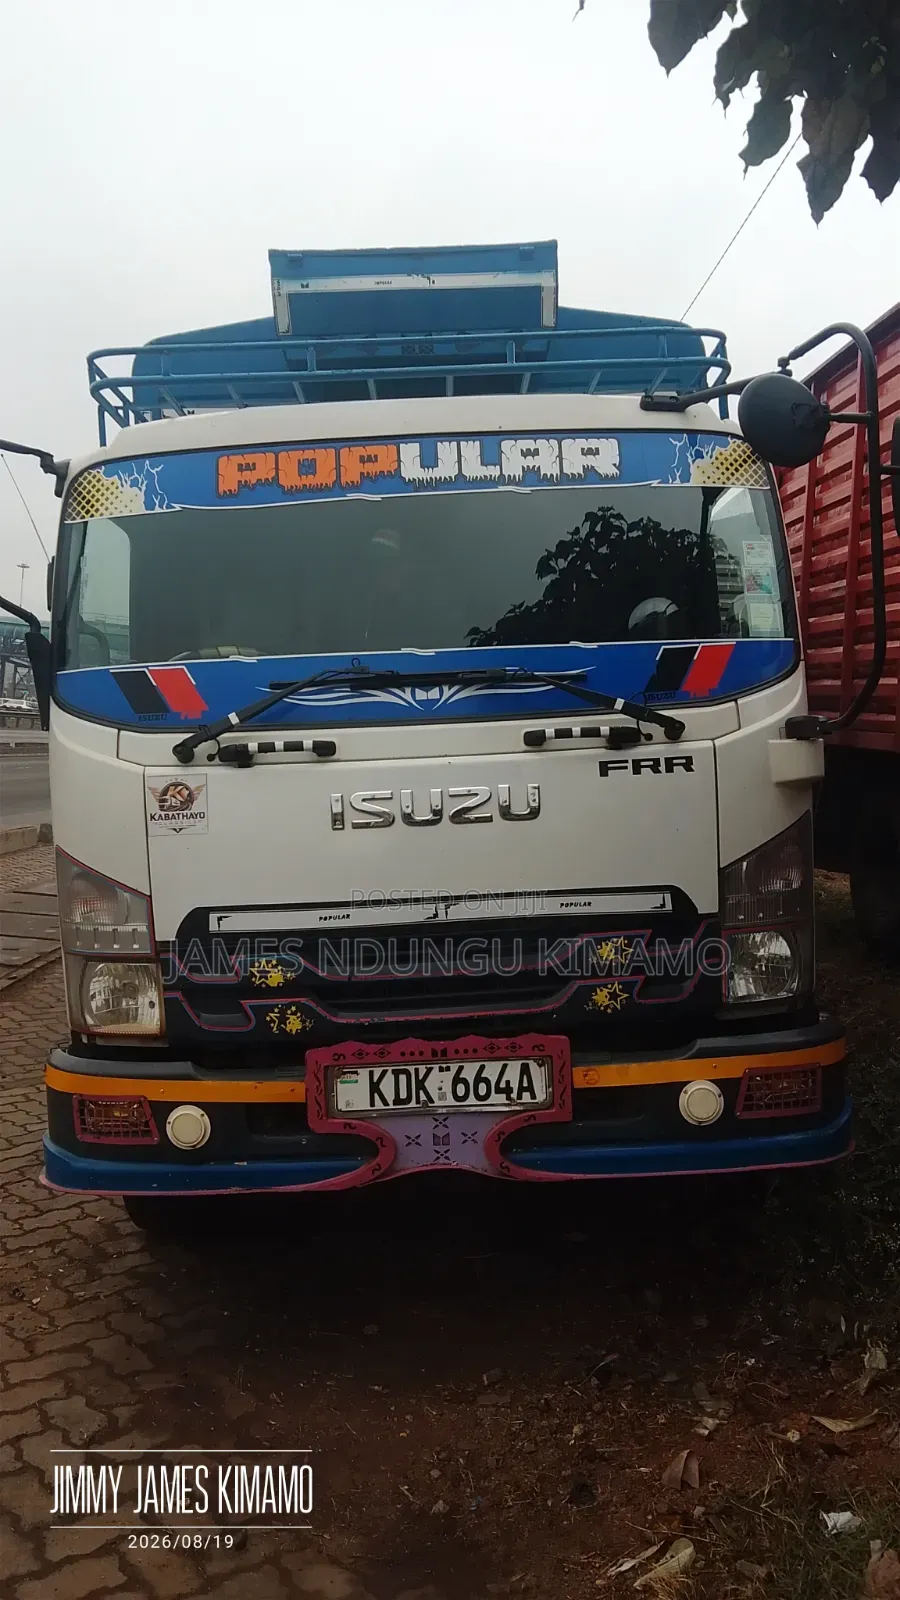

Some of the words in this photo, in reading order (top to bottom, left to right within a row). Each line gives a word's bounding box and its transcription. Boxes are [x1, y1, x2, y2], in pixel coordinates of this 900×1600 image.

[216, 438, 621, 497] POPULAR
[647, 692, 676, 701] ISUZU
[138, 713, 168, 722] ISUZU
[598, 755, 695, 778] FRR
[330, 783, 541, 831] ISUZU
[149, 811, 206, 822] KABATHAYO
[559, 901, 593, 909] POPULAR
[318, 913, 351, 922] POPULAR
[368, 1067, 435, 1107] KDK
[451, 1062, 537, 1102] 664A
